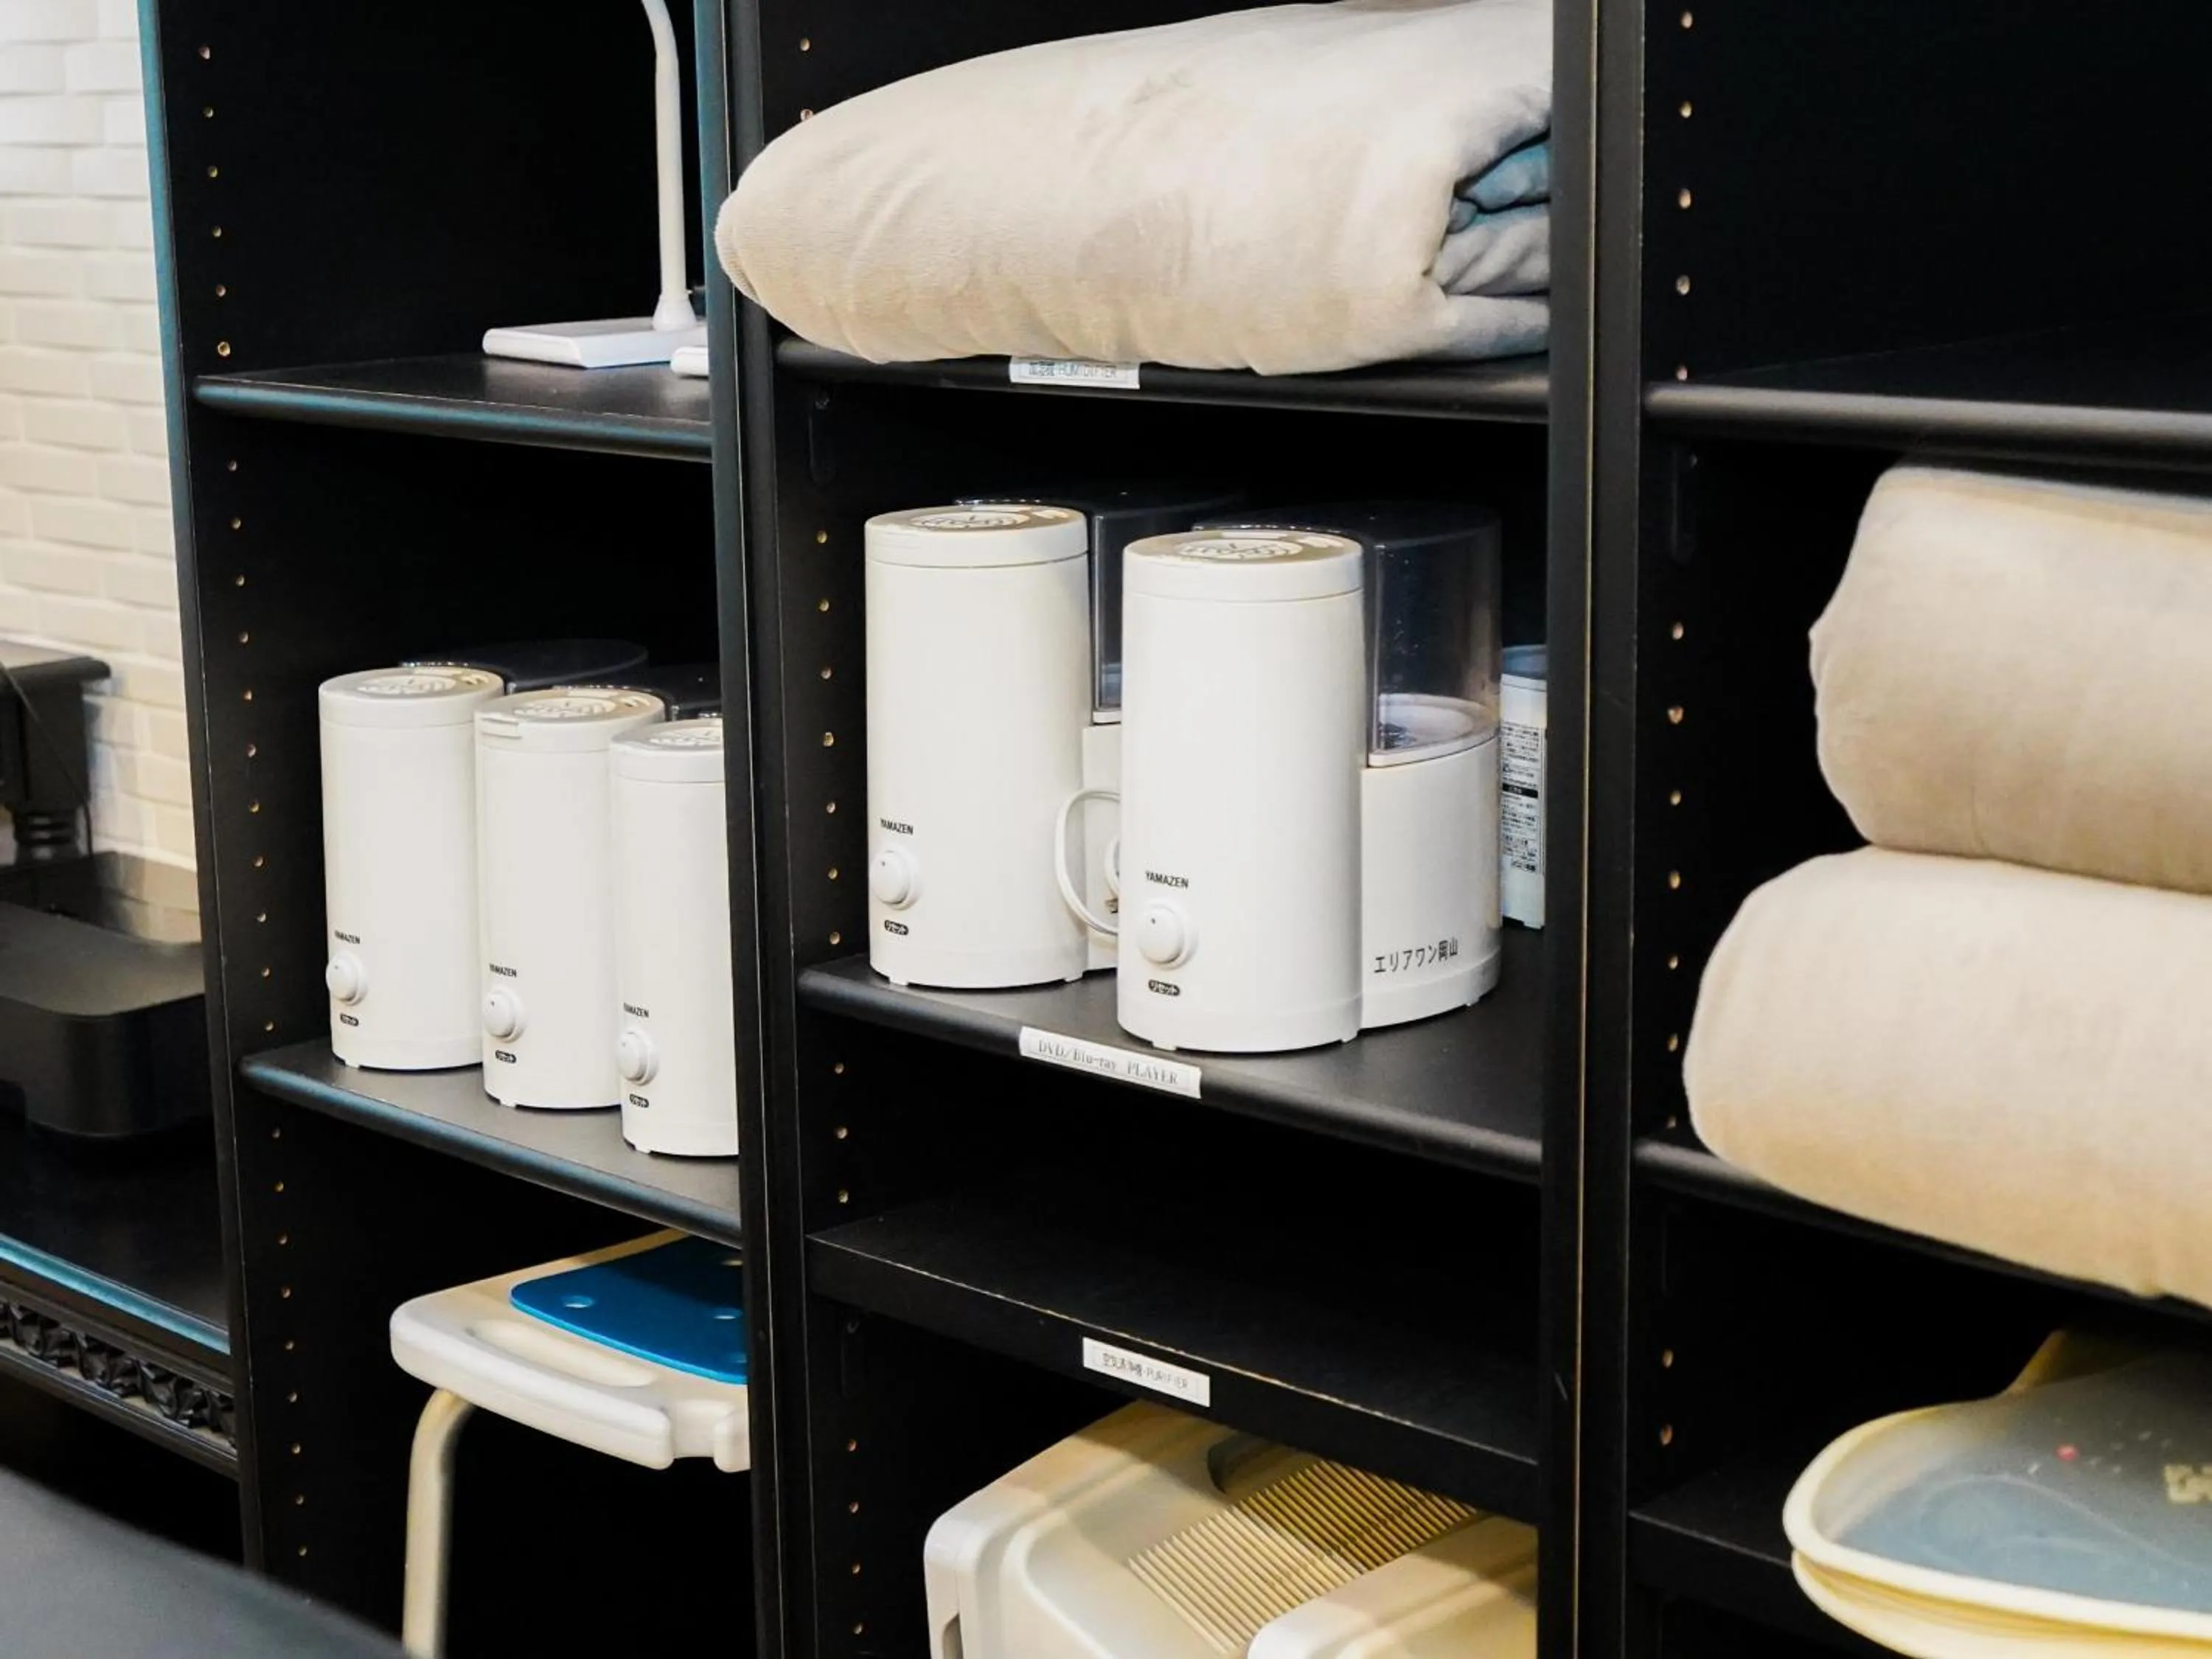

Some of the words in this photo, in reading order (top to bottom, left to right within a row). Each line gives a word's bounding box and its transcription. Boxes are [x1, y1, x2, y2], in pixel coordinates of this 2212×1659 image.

[880, 818, 914, 835] YAMAZEN
[1145, 870, 1189, 890] YAMAZEN
[1374, 936, 1458, 973] エリアワン岡山
[1038, 1039, 1116, 1071] DVD/Blu-ray
[1127, 1060, 1179, 1085] PLAYER
